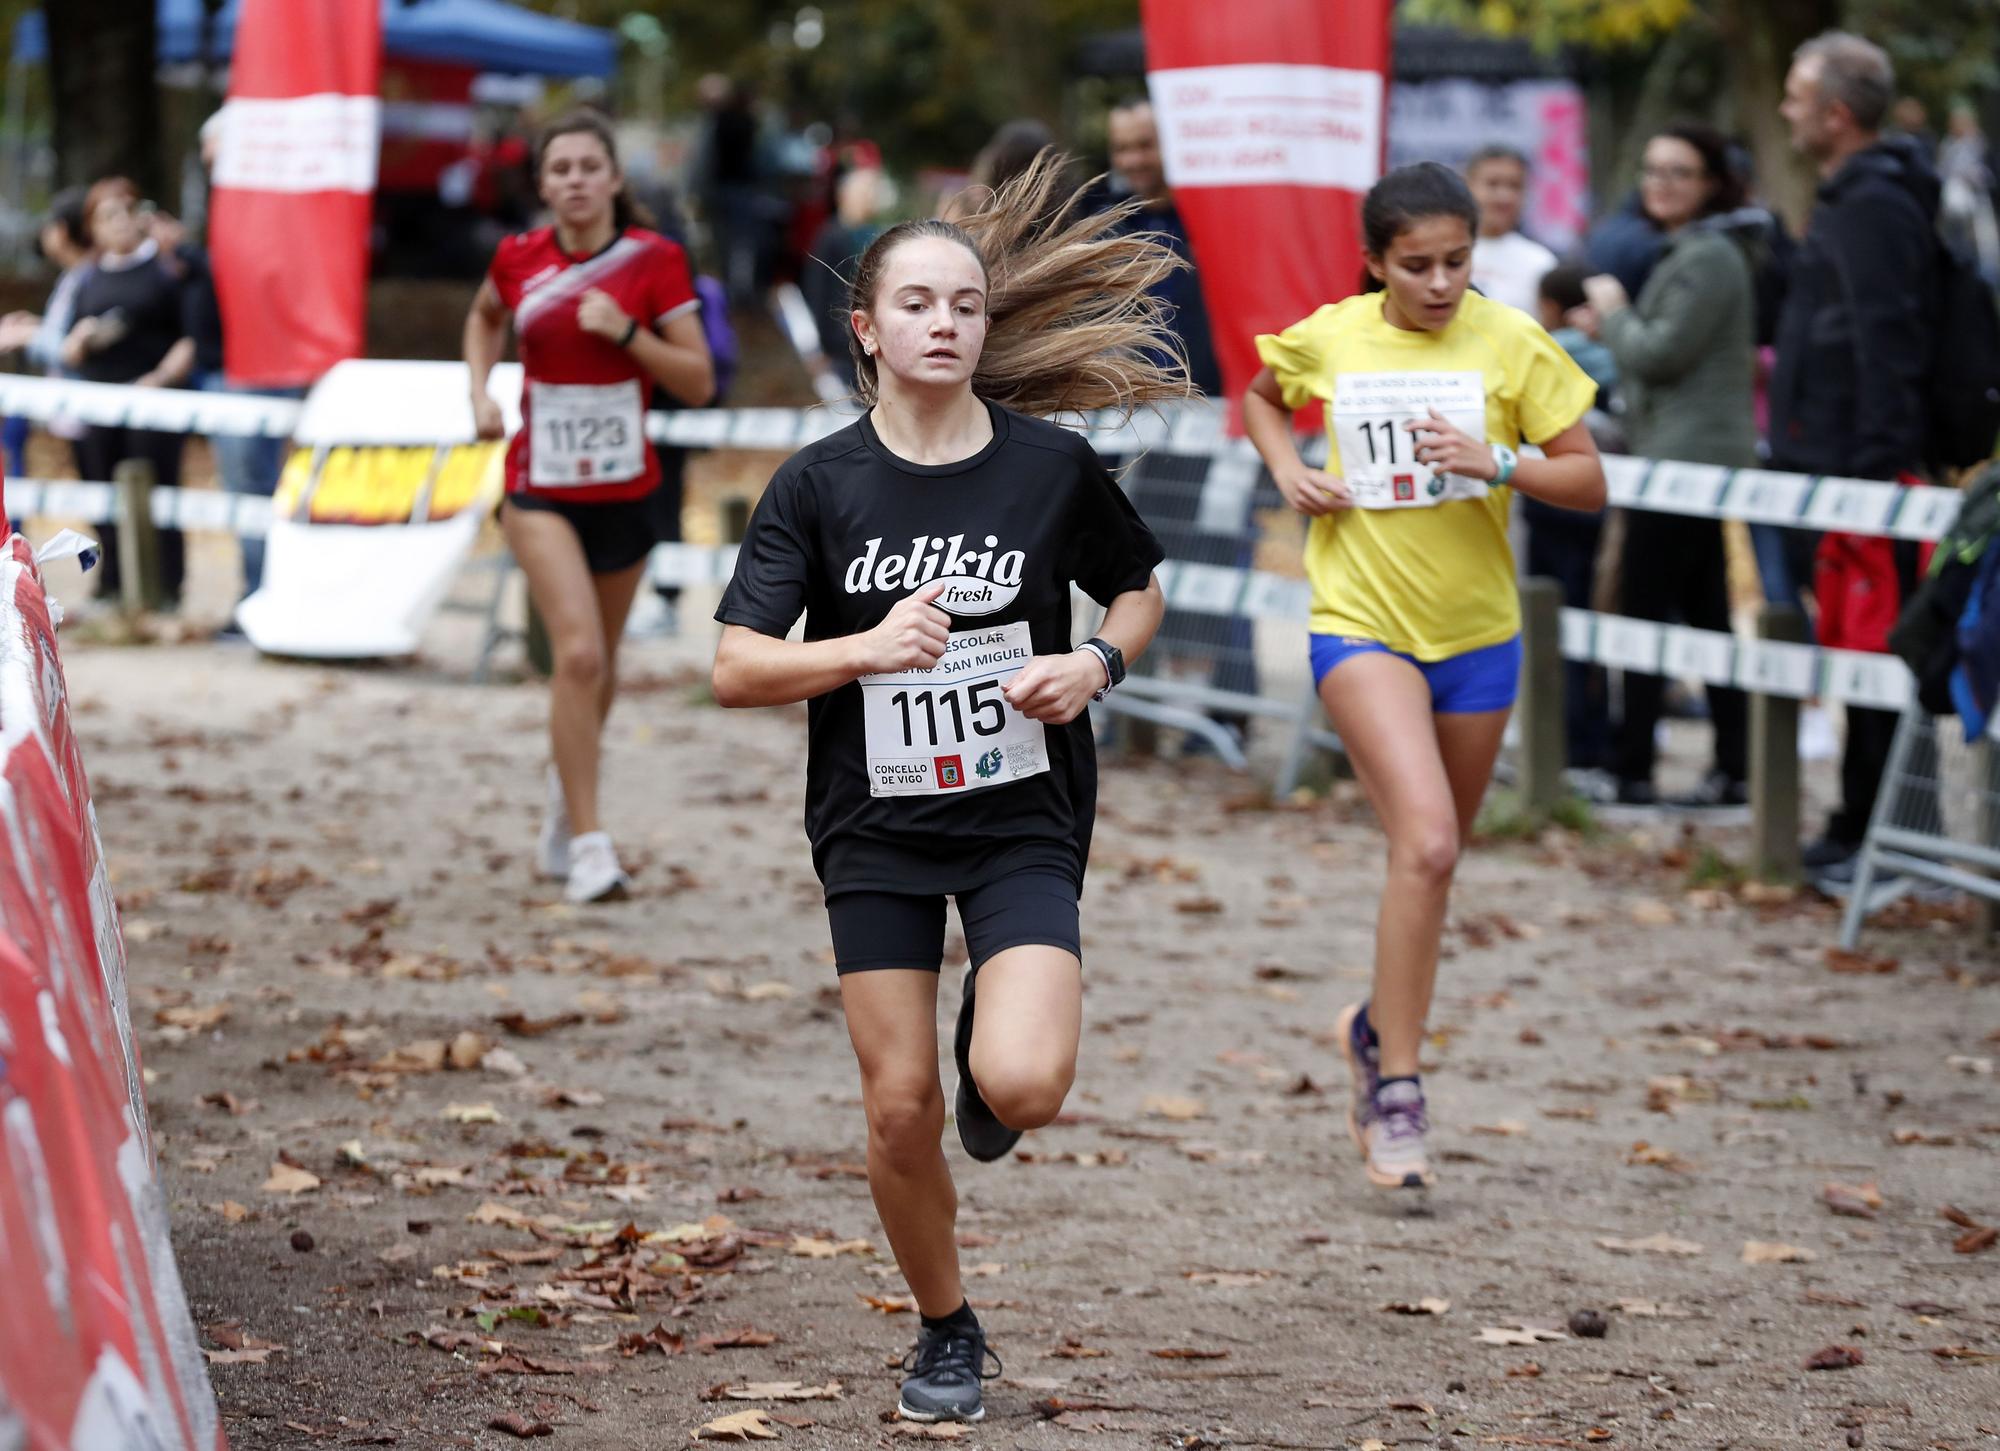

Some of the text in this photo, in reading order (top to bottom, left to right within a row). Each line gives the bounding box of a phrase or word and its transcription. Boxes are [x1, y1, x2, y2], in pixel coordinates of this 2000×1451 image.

[546, 416, 627, 452] 1123
[845, 534, 1025, 594] delikia
[946, 586, 992, 602] fresh
[946, 633, 1005, 653] ESCOLAR
[944, 658, 971, 674] SAN
[976, 648, 1028, 666] MIGUEL
[892, 679, 1006, 747] 1115
[875, 764, 927, 774] CONCELLO
[881, 775, 923, 784] DE VIGO
